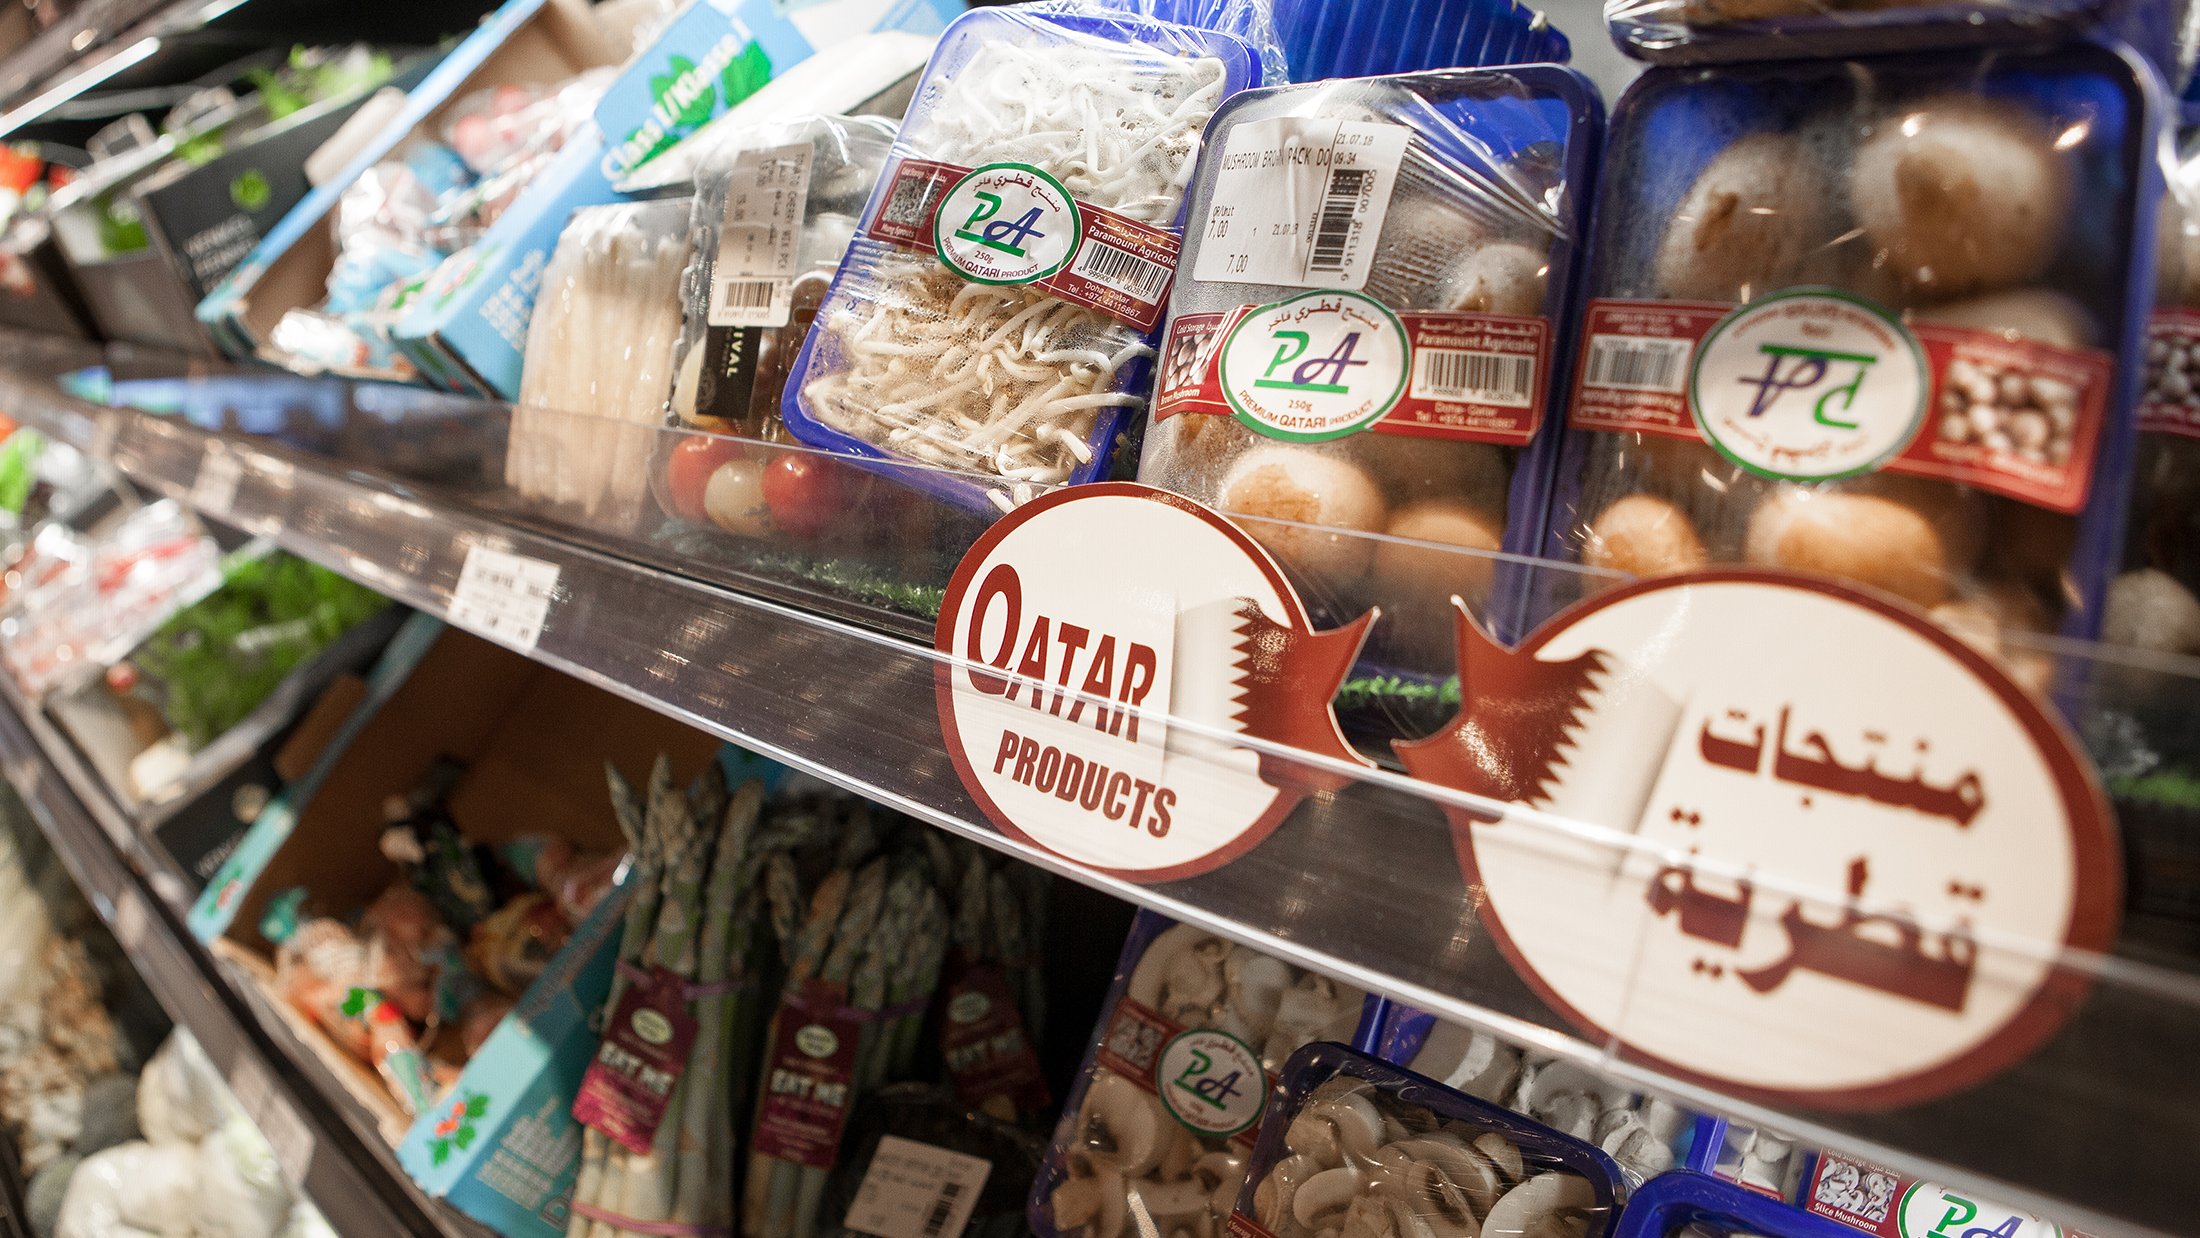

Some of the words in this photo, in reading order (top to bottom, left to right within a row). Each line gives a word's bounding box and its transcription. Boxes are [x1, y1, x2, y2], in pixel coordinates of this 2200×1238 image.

[1336, 133, 1375, 146] 21.07.18
[1221, 151, 1261, 171] MUSHROOM
[993, 173, 1035, 189] قطري
[942, 236, 966, 267] PREMIUM
[964, 261, 1000, 278] QATARI
[1000, 263, 1039, 279] PRODUCT
[974, 250, 995, 265] 250g
[1088, 225, 1138, 251] Paramount
[1138, 245, 1178, 268] Agricole
[1226, 254, 1249, 274] 7,00
[1068, 283, 1081, 294] Tel
[1084, 290, 1103, 304] +974
[1108, 290, 1131, 305] Qatar
[1294, 298, 1343, 323] قطري
[1416, 331, 1481, 347] Paramount
[726, 326, 745, 378] IVAL
[1238, 389, 1279, 423] PREMIUM
[1279, 414, 1327, 430] QATARI
[1287, 399, 1313, 413] 250g
[967, 563, 1157, 743] QATAR
[1698, 703, 1987, 829] منتجات
[992, 728, 1177, 839] PRODUCTS
[1644, 808, 1983, 1017] قطرية
[1813, 1202, 1834, 1218] Slice
[1833, 1209, 1878, 1233] Mushroom
